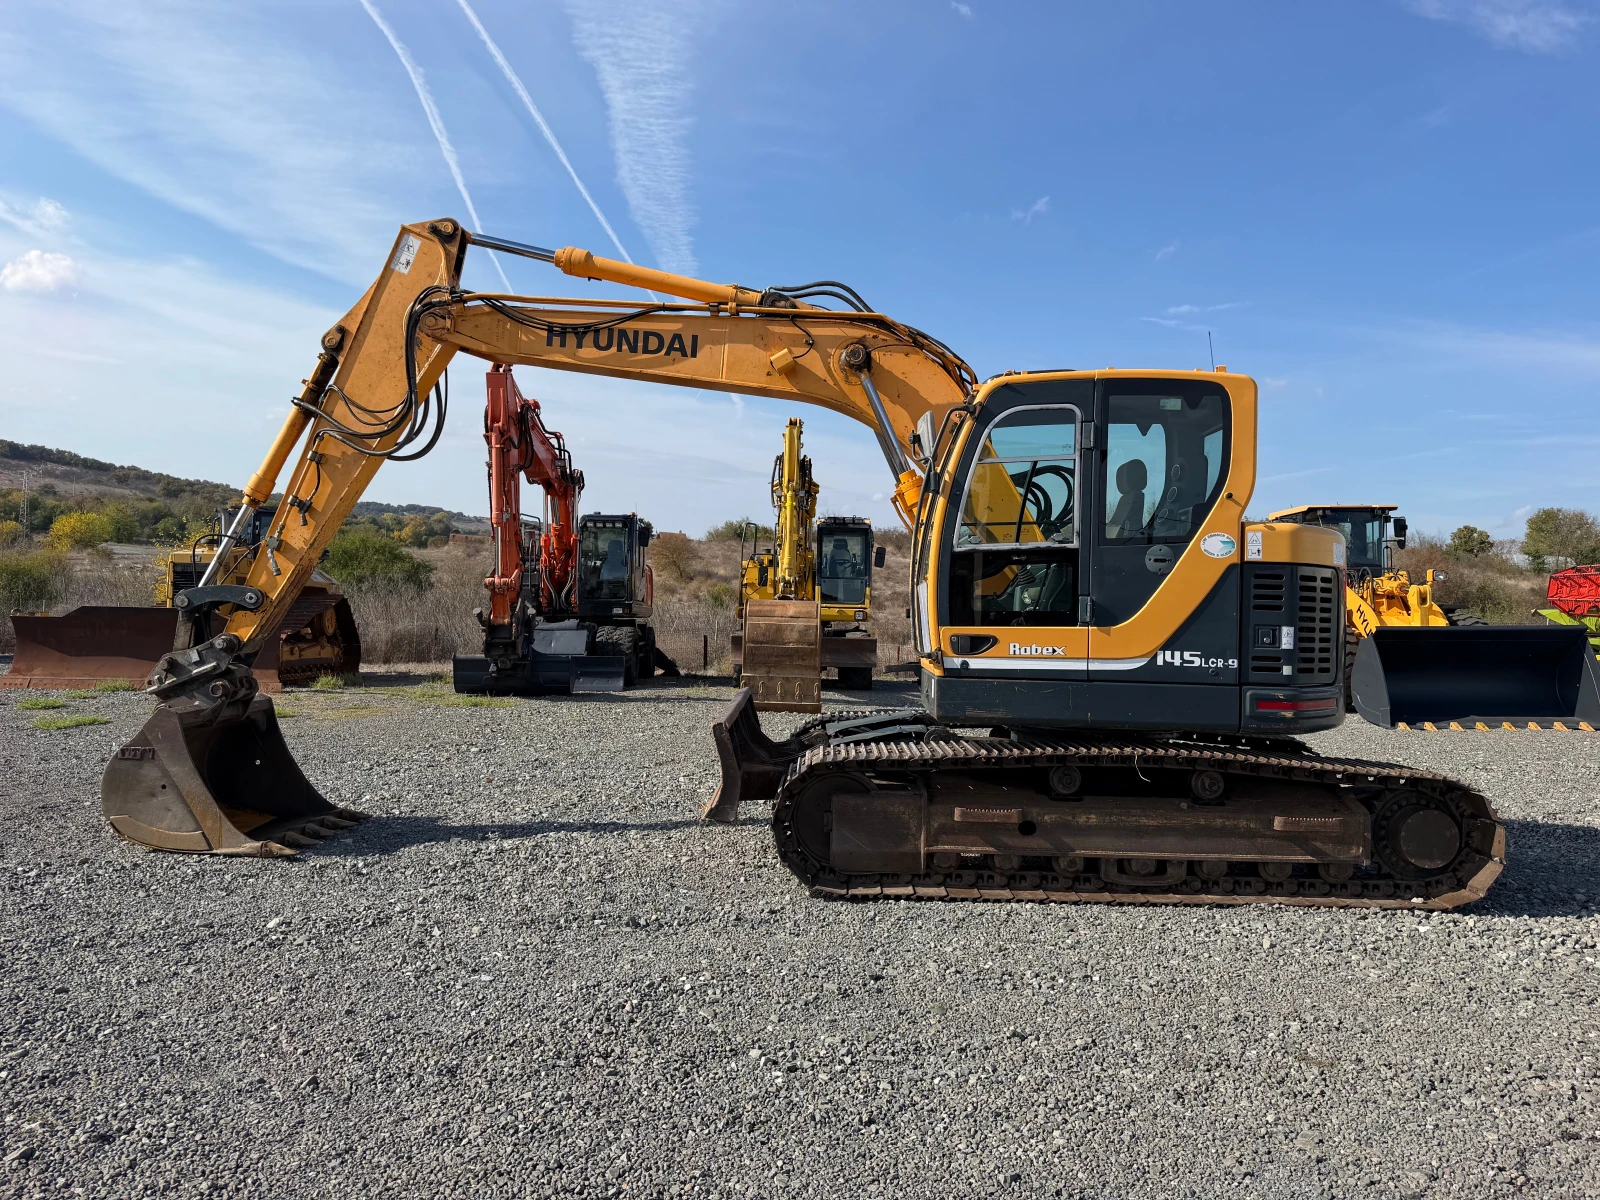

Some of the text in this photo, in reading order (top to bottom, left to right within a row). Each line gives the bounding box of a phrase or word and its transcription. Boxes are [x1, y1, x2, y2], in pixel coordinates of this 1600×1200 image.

[546, 325, 699, 359] HYUNDAI
[1356, 603, 1374, 637] HYU
[1008, 642, 1067, 656] Robex
